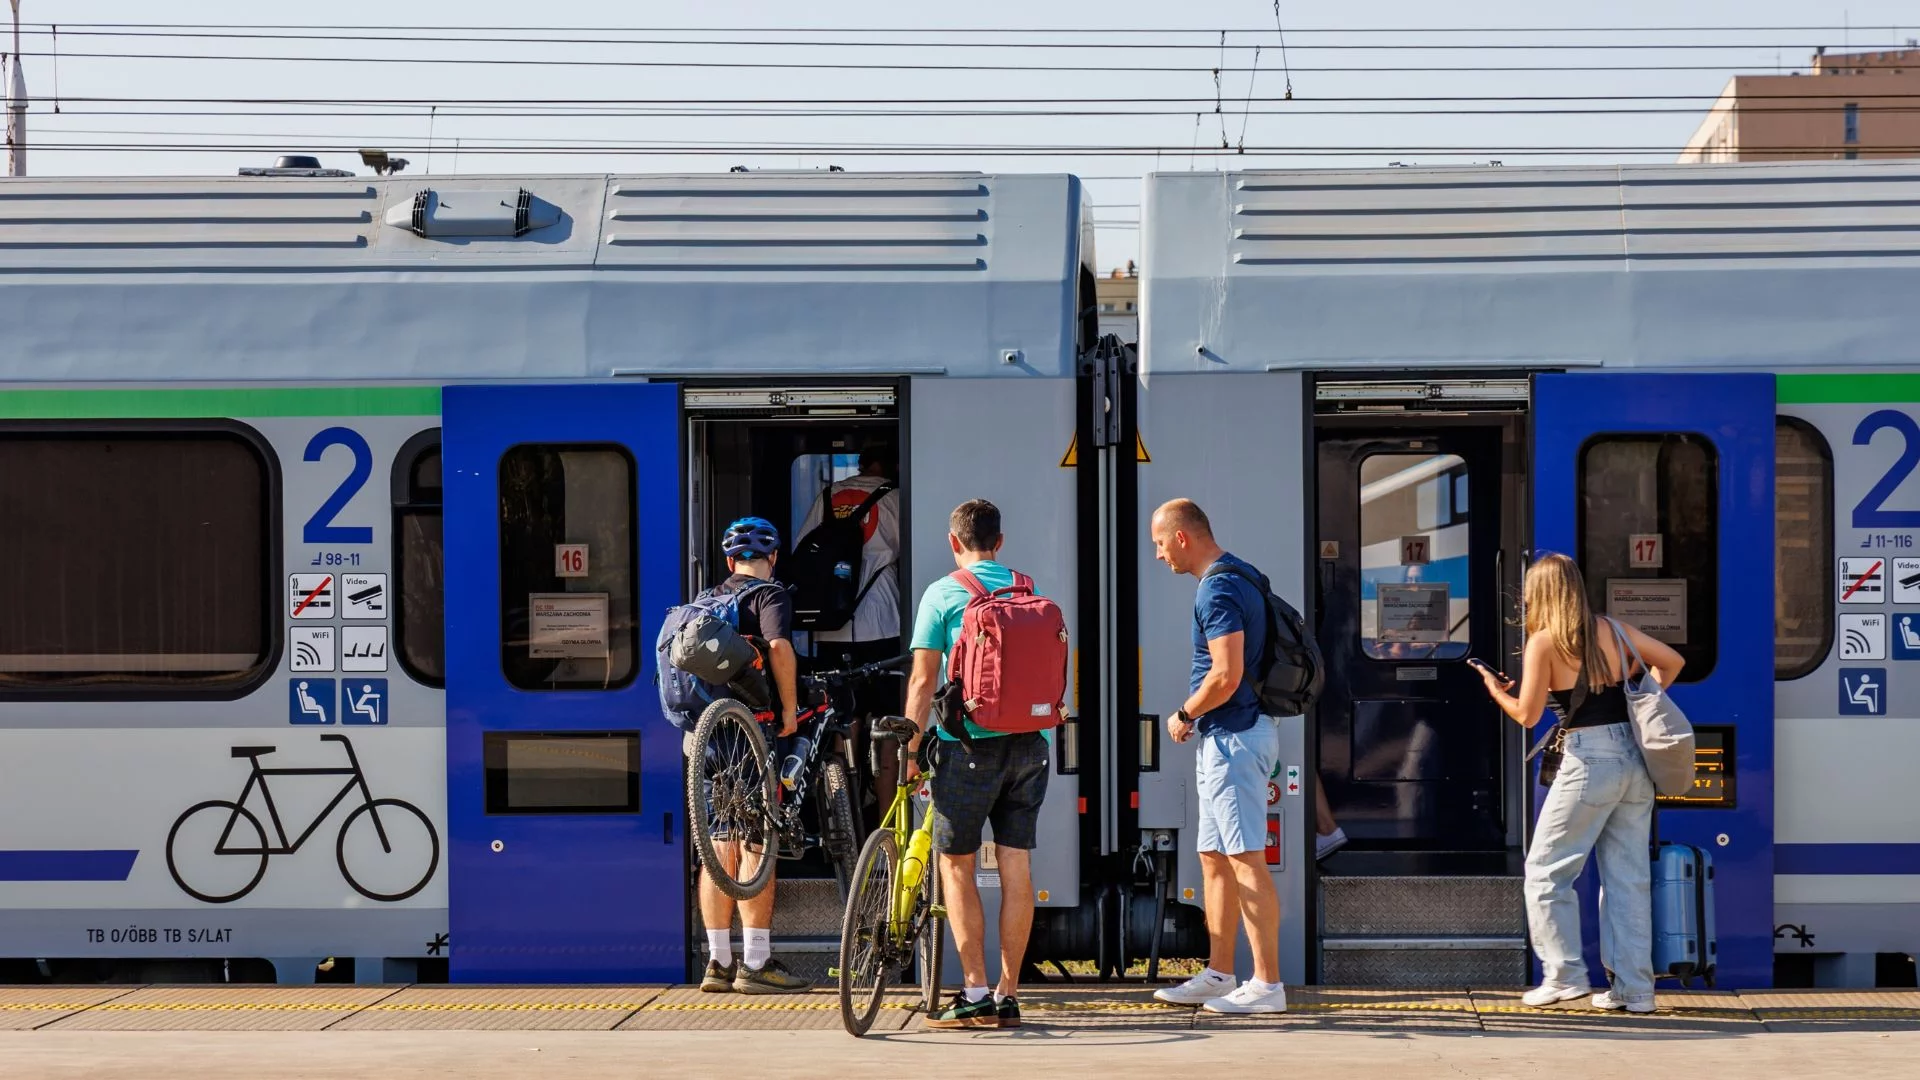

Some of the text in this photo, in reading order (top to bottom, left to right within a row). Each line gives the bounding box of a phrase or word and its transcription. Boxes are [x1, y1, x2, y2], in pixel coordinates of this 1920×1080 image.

[1852, 409, 1920, 528] 2
[303, 426, 373, 543] 2
[1635, 540, 1656, 561] 17
[1876, 534, 1912, 548] 11-116
[325, 552, 360, 566] 98-11
[562, 550, 582, 572] 16
[1406, 542, 1425, 561] 17
[312, 631, 329, 639] WiFi
[86, 928, 105, 943] TB
[163, 928, 182, 943] TB
[187, 928, 233, 943] S/LAT
